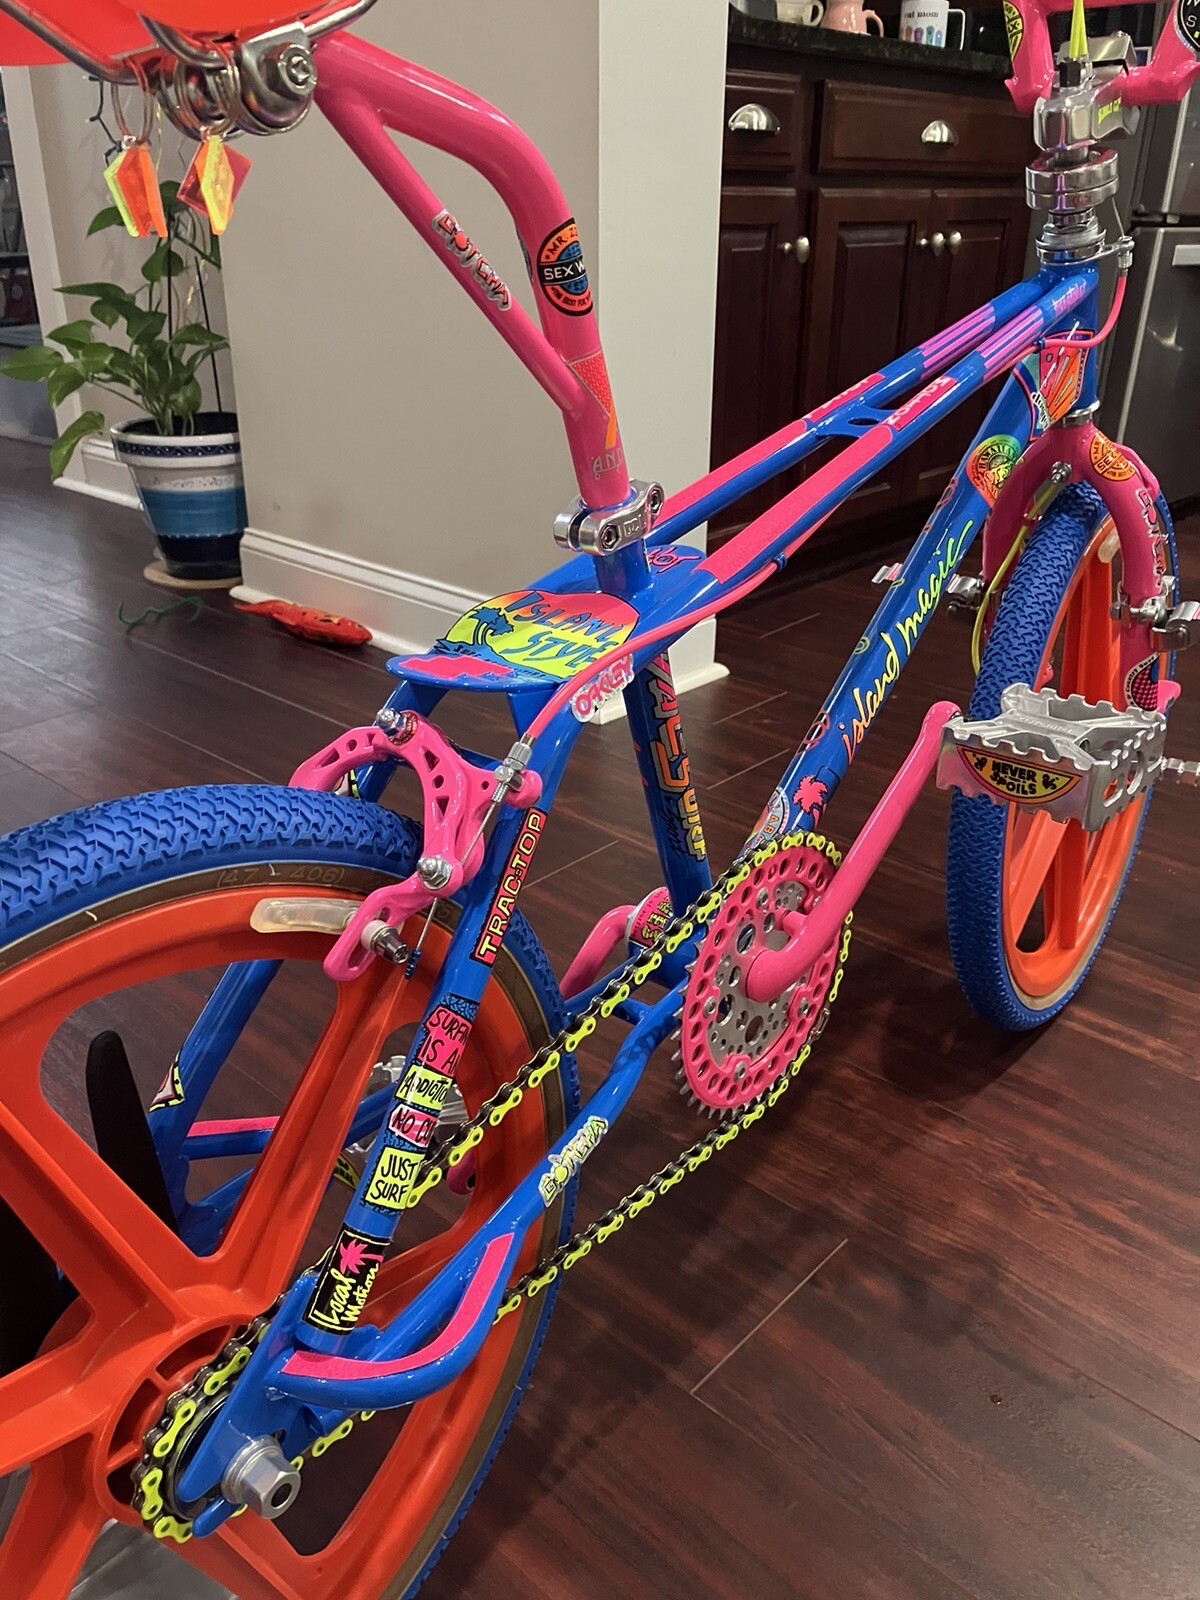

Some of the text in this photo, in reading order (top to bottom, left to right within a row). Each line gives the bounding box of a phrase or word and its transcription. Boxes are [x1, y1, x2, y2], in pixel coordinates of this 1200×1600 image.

[543, 264, 574, 280] SEX
[841, 521, 973, 762] island magic
[575, 654, 633, 716] OAKLEY
[989, 771, 1037, 795] SPOILS
[991, 760, 1038, 783] NEVER
[421, 1036, 445, 1063] IS
[392, 1107, 415, 1134] NO
[380, 1153, 419, 1182] JUST
[369, 1178, 409, 1205] SURF
